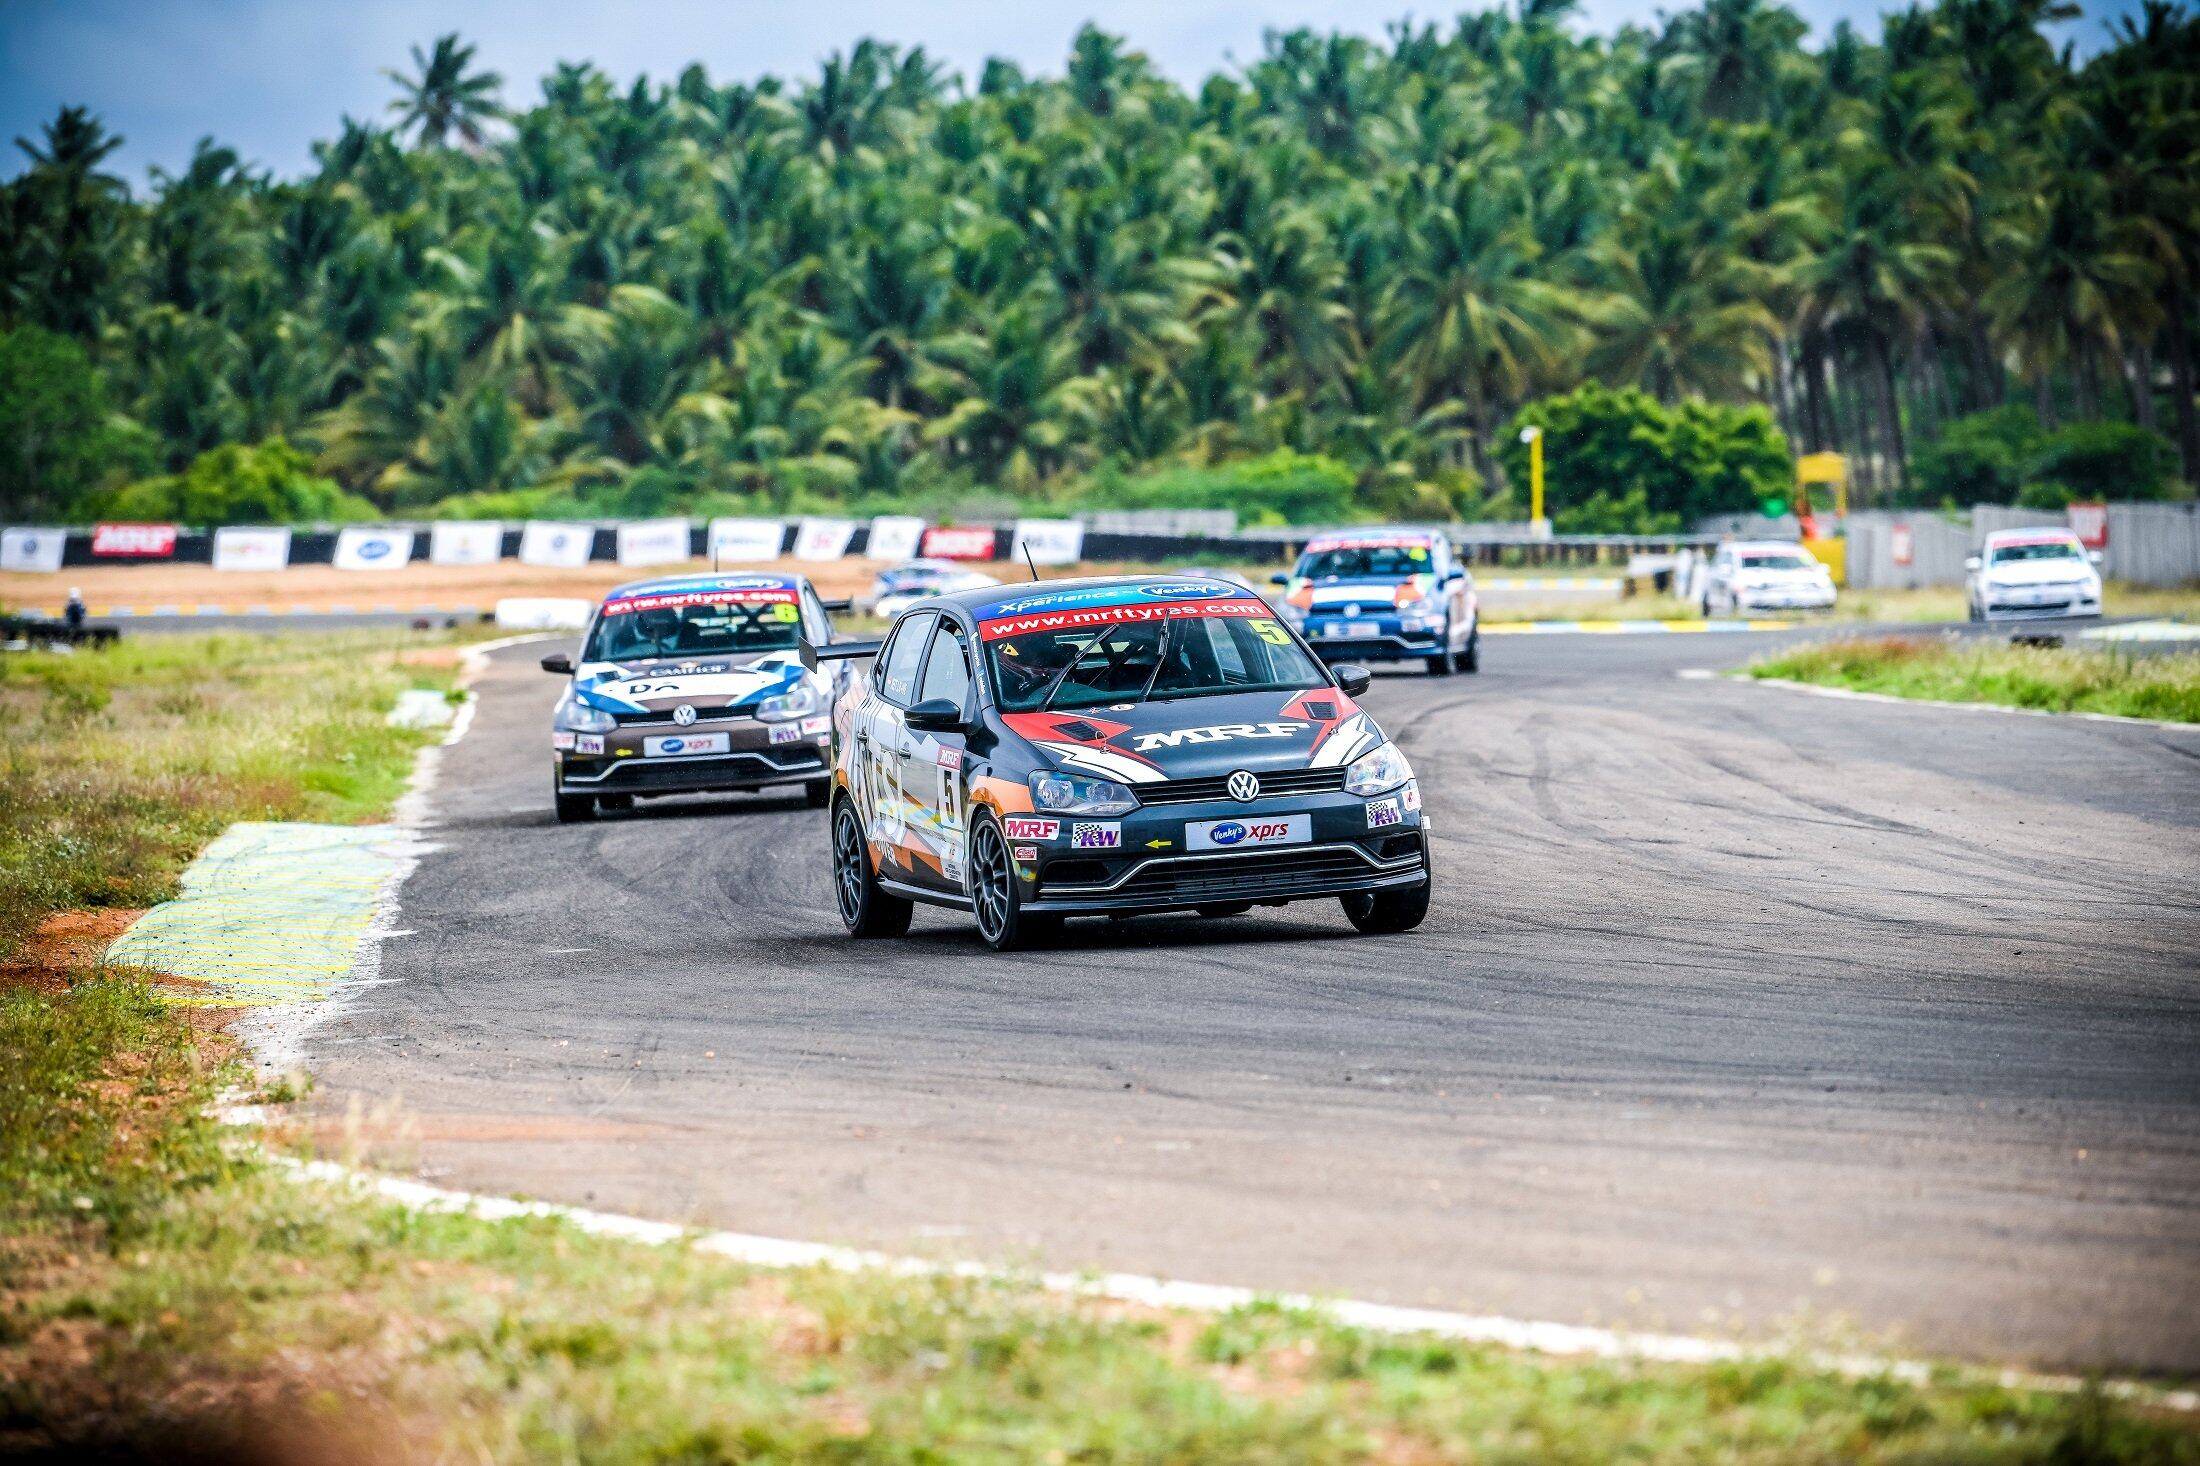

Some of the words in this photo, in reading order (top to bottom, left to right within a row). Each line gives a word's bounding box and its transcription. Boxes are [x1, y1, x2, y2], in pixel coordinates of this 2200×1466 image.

[991, 604, 1264, 635] www.mrftyres.com
[1247, 619, 1292, 646] 5
[1132, 722, 1311, 751] MRF
[940, 749, 959, 765] MRF
[943, 770, 955, 823] 5
[1007, 820, 1059, 837] MRF
[1080, 830, 1120, 846] KW
[1214, 827, 1243, 840] Venky's
[1247, 824, 1289, 841] xprs
